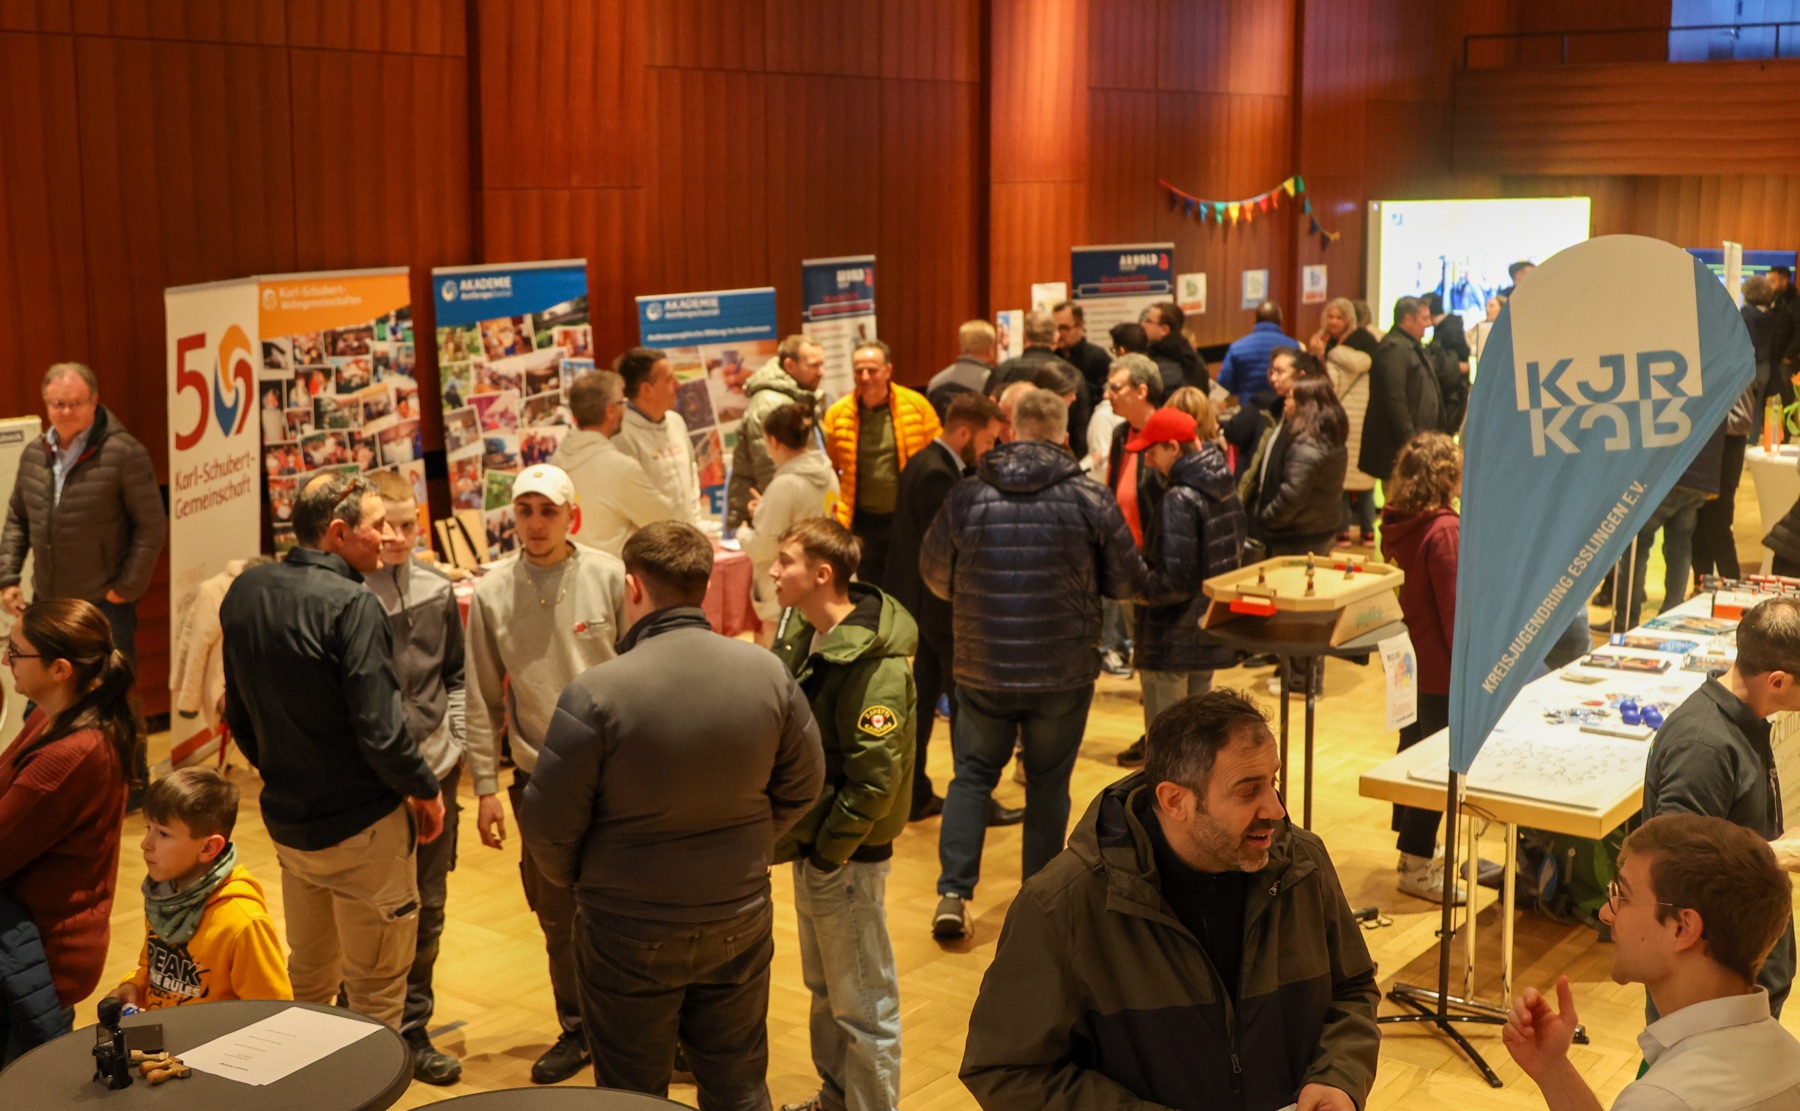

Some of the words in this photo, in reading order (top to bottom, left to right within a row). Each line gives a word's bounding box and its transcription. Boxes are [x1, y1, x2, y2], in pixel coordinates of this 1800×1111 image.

[1526, 350, 1689, 409] KJR
[176, 452, 255, 493] Karl-Schubert-
[176, 475, 251, 520] Gemeinschaft
[1481, 574, 1574, 694] KREISJUGENDRING
[1568, 502, 1629, 577] ESSLINGEN
[1622, 480, 1648, 506] E.V.
[163, 977, 200, 999] RULES
